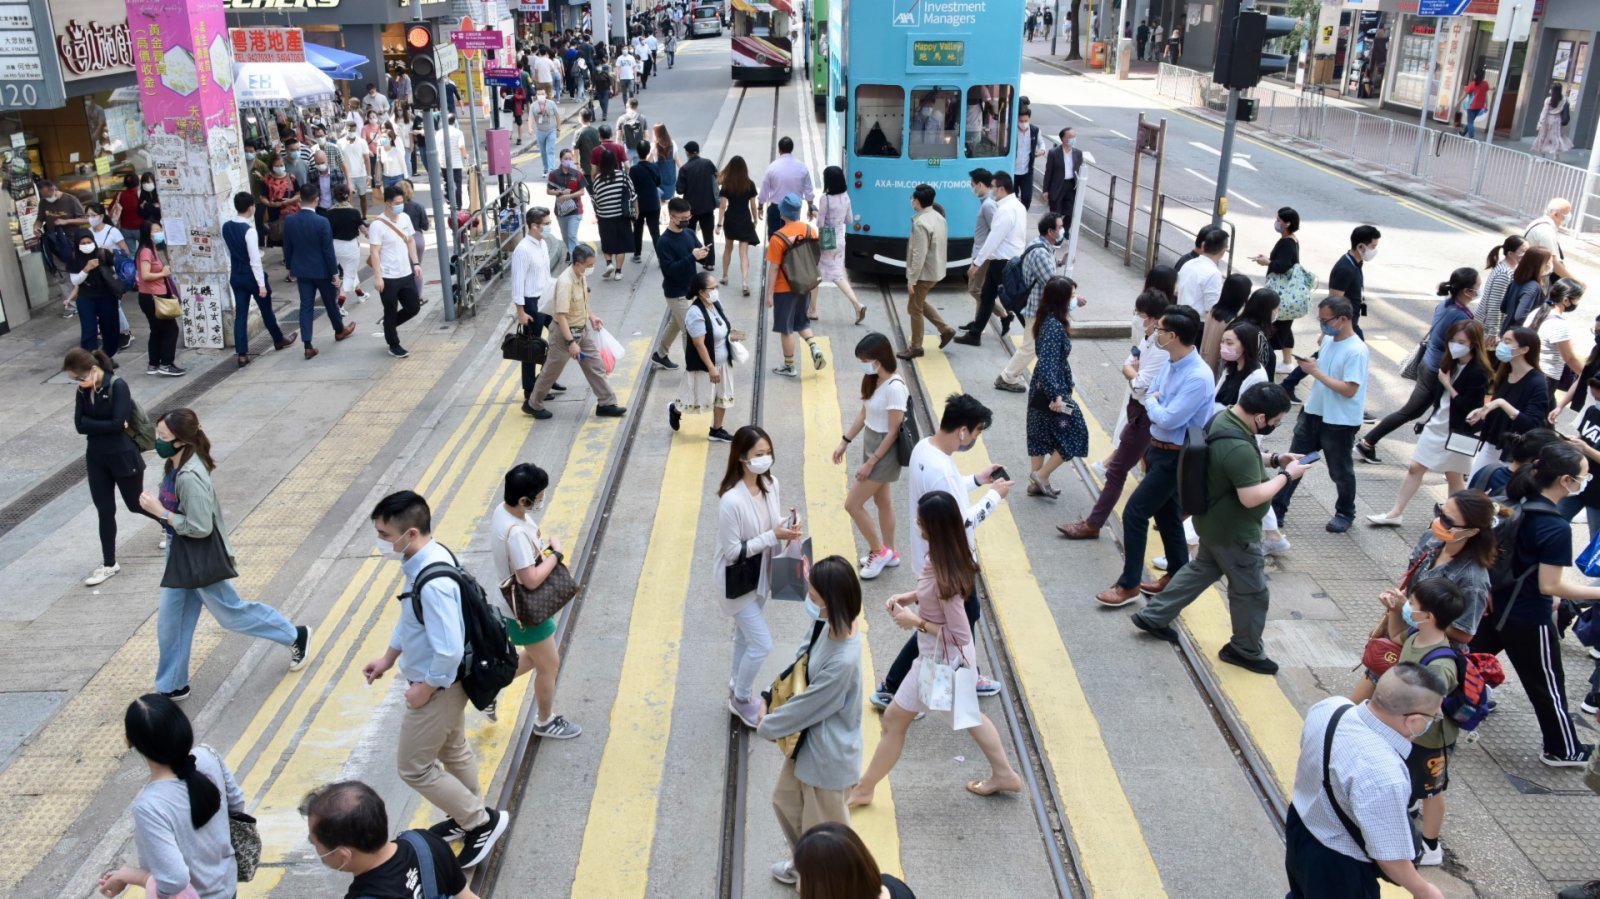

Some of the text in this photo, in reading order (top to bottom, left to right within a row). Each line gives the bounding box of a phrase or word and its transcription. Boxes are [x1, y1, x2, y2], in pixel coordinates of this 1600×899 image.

[924, 1, 986, 12] Investment
[893, 12, 915, 24] AXA
[923, 13, 976, 27] Managers
[232, 29, 304, 52] 粵港地產
[914, 42, 964, 52] Happy Valley
